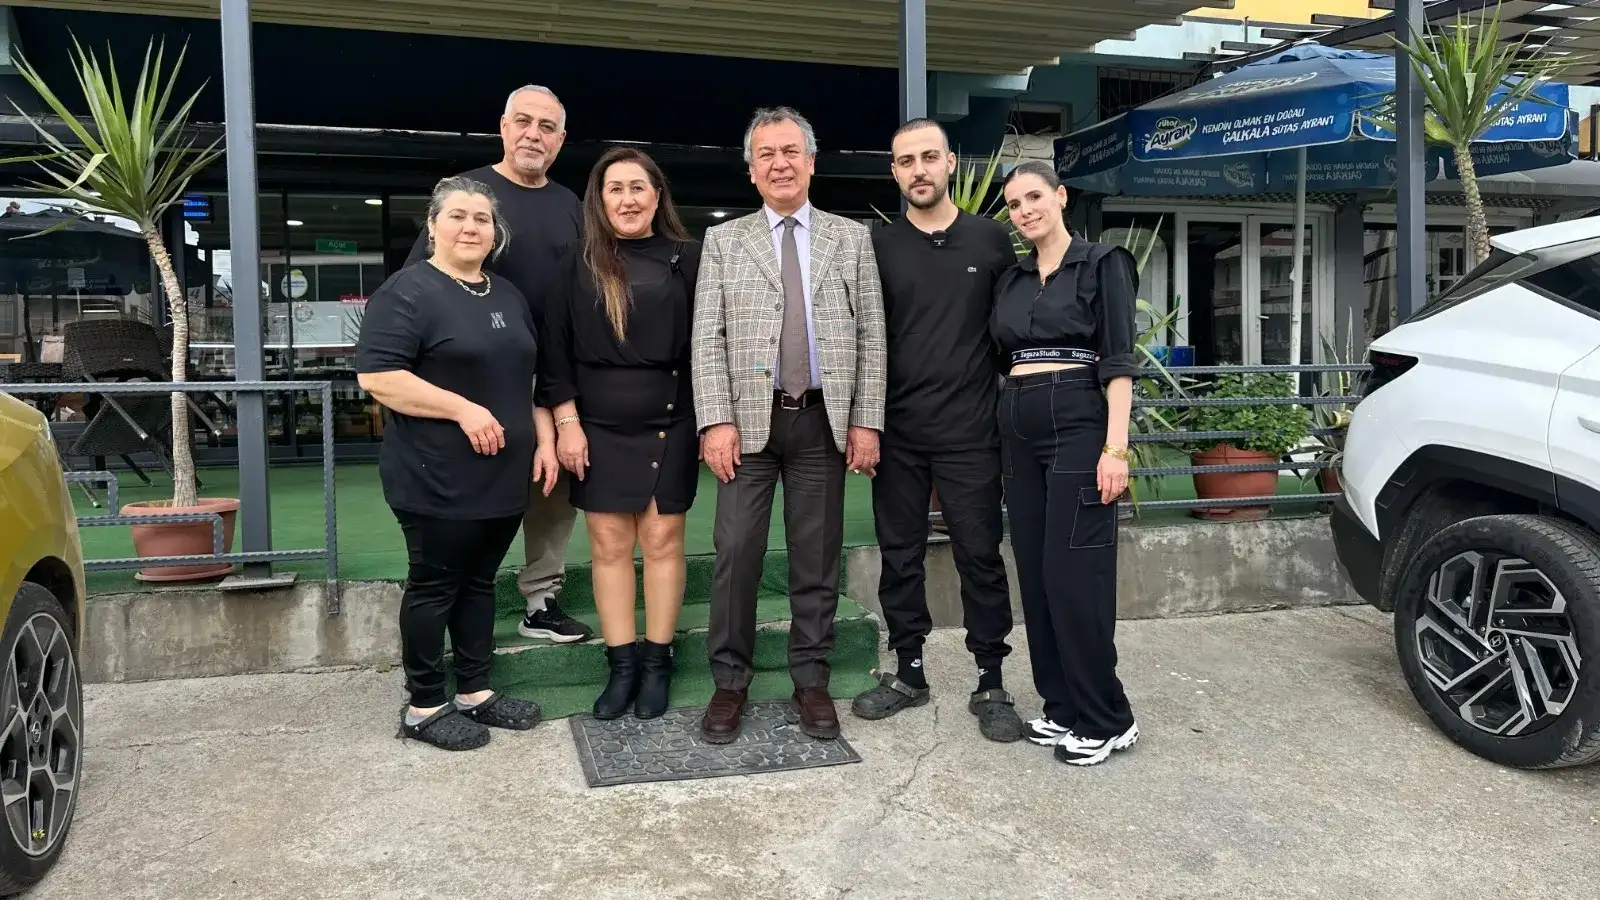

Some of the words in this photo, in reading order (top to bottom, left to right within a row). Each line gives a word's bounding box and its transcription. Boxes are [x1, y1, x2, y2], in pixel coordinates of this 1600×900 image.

[1233, 116, 1262, 129] OLMAK
[1263, 113, 1275, 124] EN
[1151, 124, 1192, 149] Ayran
[1222, 125, 1270, 145] ÇALKALA
[632, 724, 789, 750] Welme
